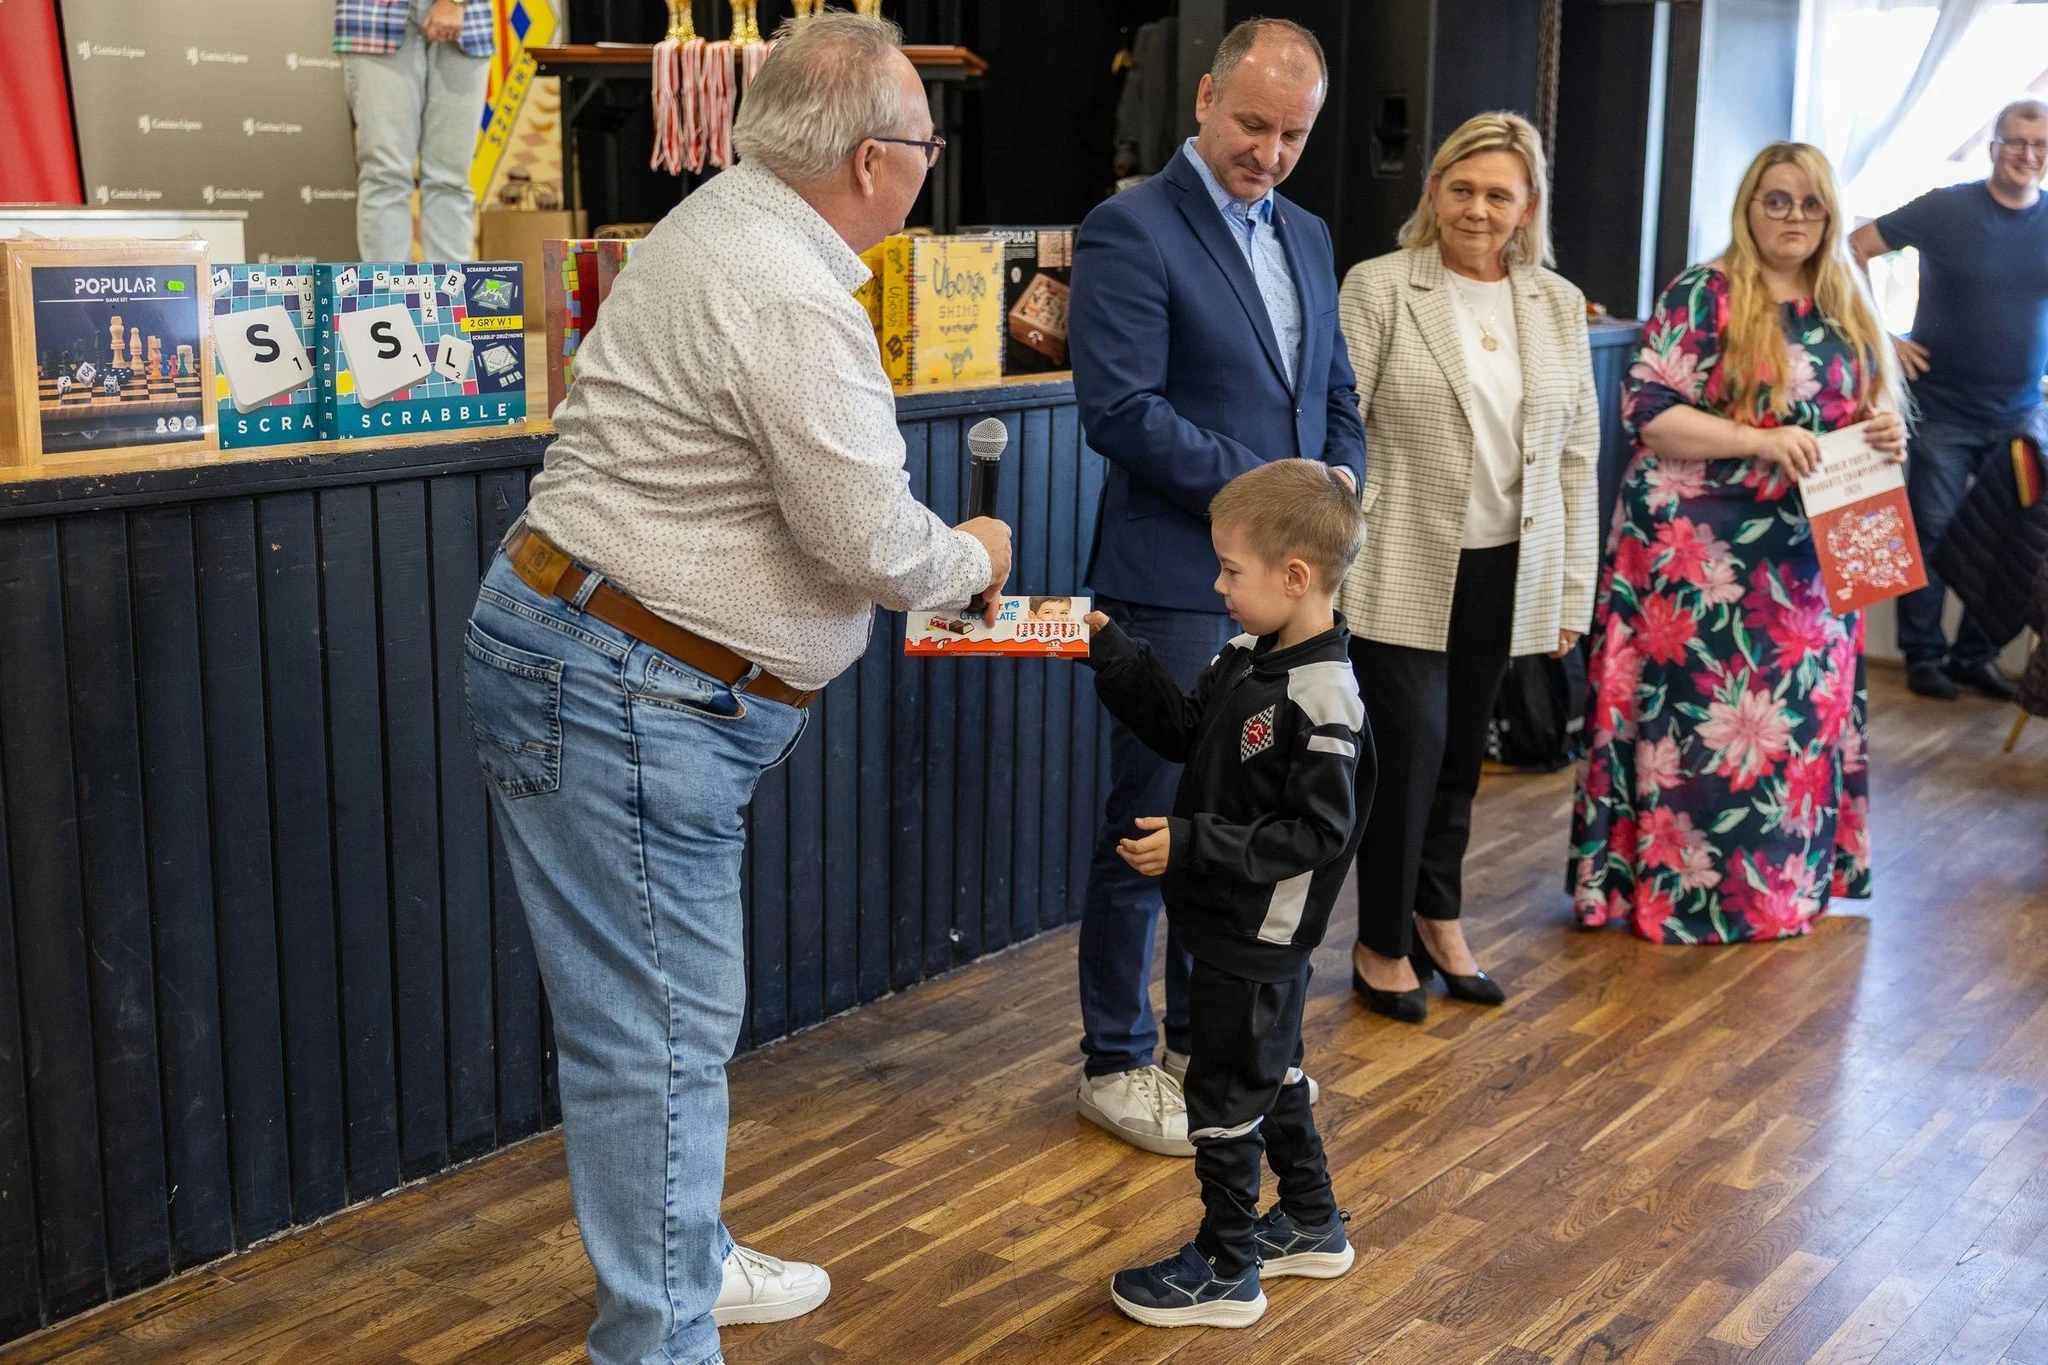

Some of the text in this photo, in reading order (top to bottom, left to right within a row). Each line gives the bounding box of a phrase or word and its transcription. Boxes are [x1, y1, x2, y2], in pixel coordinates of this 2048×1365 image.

[74, 277, 157, 295] POPULAR
[213, 275, 223, 286] H
[341, 274, 350, 286] H
[447, 275, 458, 287] B
[470, 319, 475, 328] 2
[477, 318, 495, 327] GRY
[497, 318, 506, 326] W
[246, 323, 281, 363] S
[370, 321, 402, 359] S
[292, 356, 303, 371] 1
[321, 297, 333, 420] SCRABBLE
[412, 353, 422, 367] 1
[445, 347, 456, 368] L
[455, 371, 461, 380] 2
[361, 403, 508, 428] SCRABBLE
[237, 415, 314, 434] SCRA
